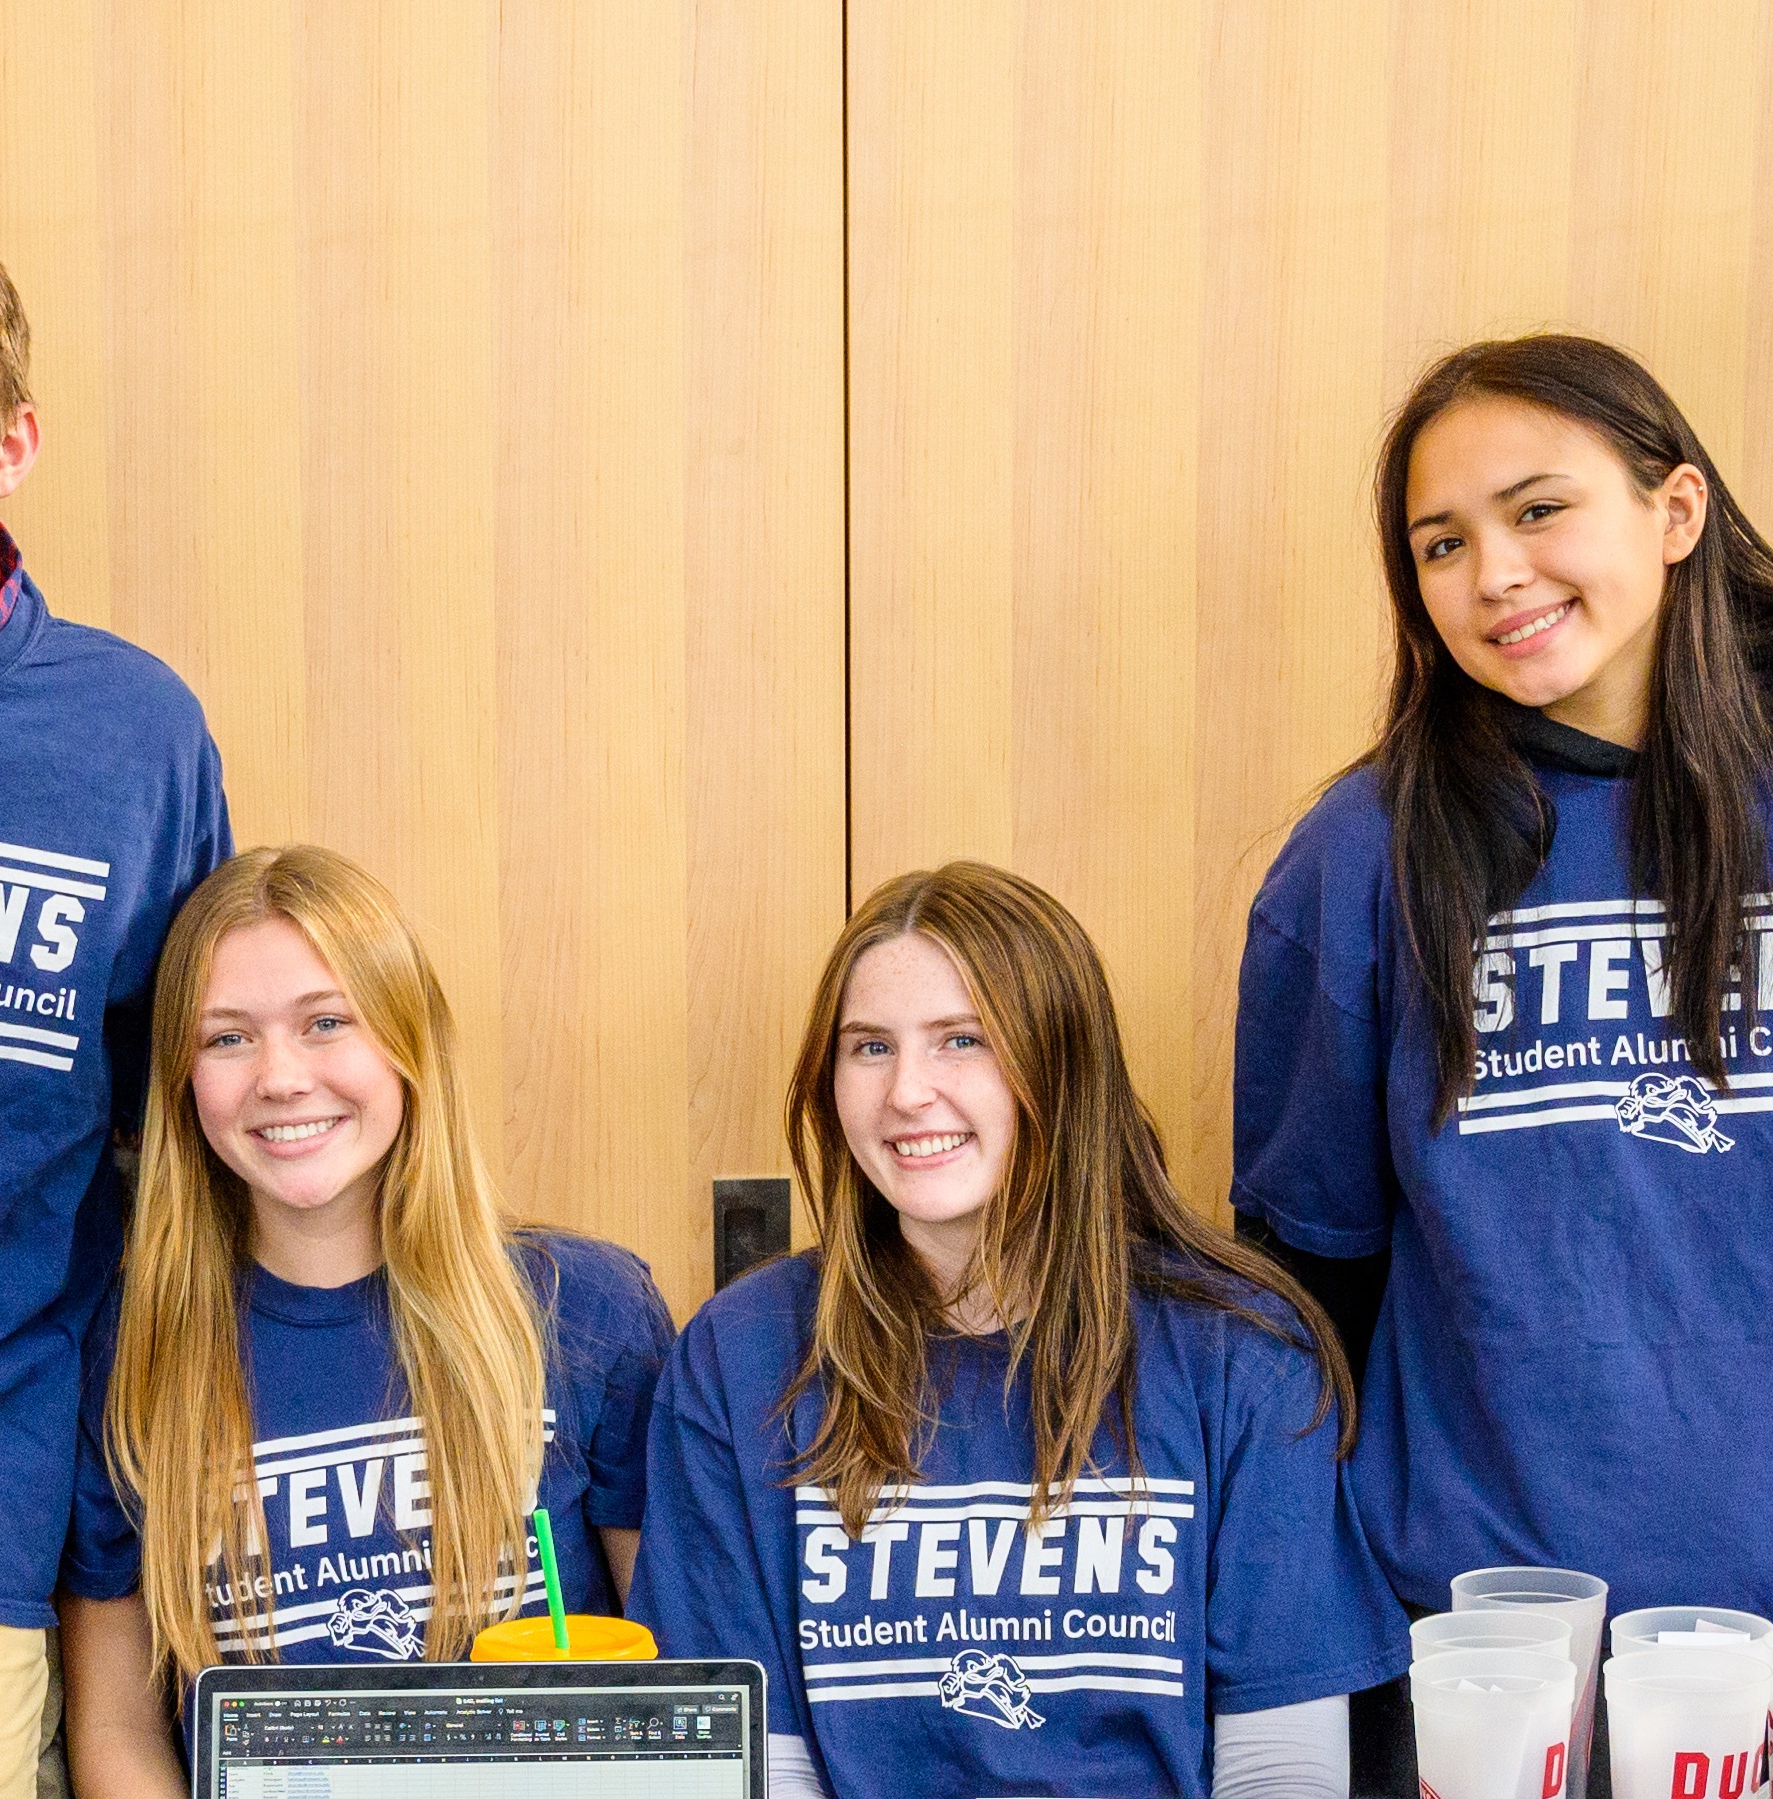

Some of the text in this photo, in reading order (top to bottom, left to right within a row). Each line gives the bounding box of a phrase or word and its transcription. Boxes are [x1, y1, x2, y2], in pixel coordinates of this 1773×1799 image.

[1474, 1035, 1601, 1080] Student
[206, 1541, 432, 1611] tudent Alumni
[802, 1517, 1177, 1603] STEVENS
[800, 1609, 1176, 1650] Student Alumni Council
